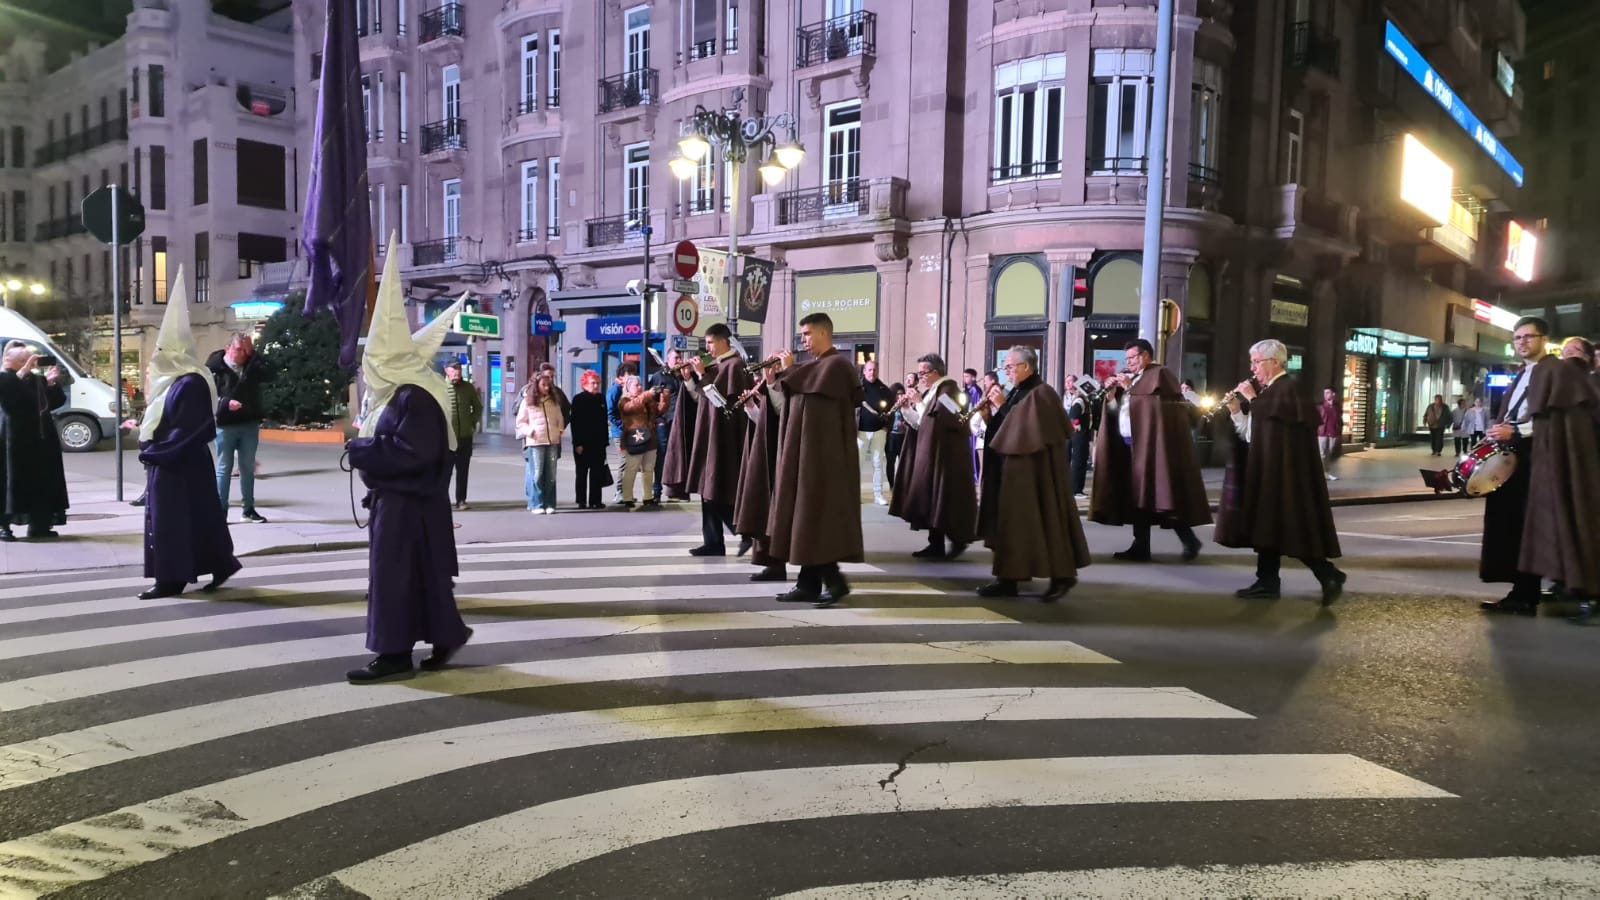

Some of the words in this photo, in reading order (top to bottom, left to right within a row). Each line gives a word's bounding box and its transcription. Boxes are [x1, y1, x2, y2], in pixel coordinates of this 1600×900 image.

[834, 298, 870, 307] ROCHER
[680, 308, 692, 321] 10
[600, 323, 624, 335] visión
